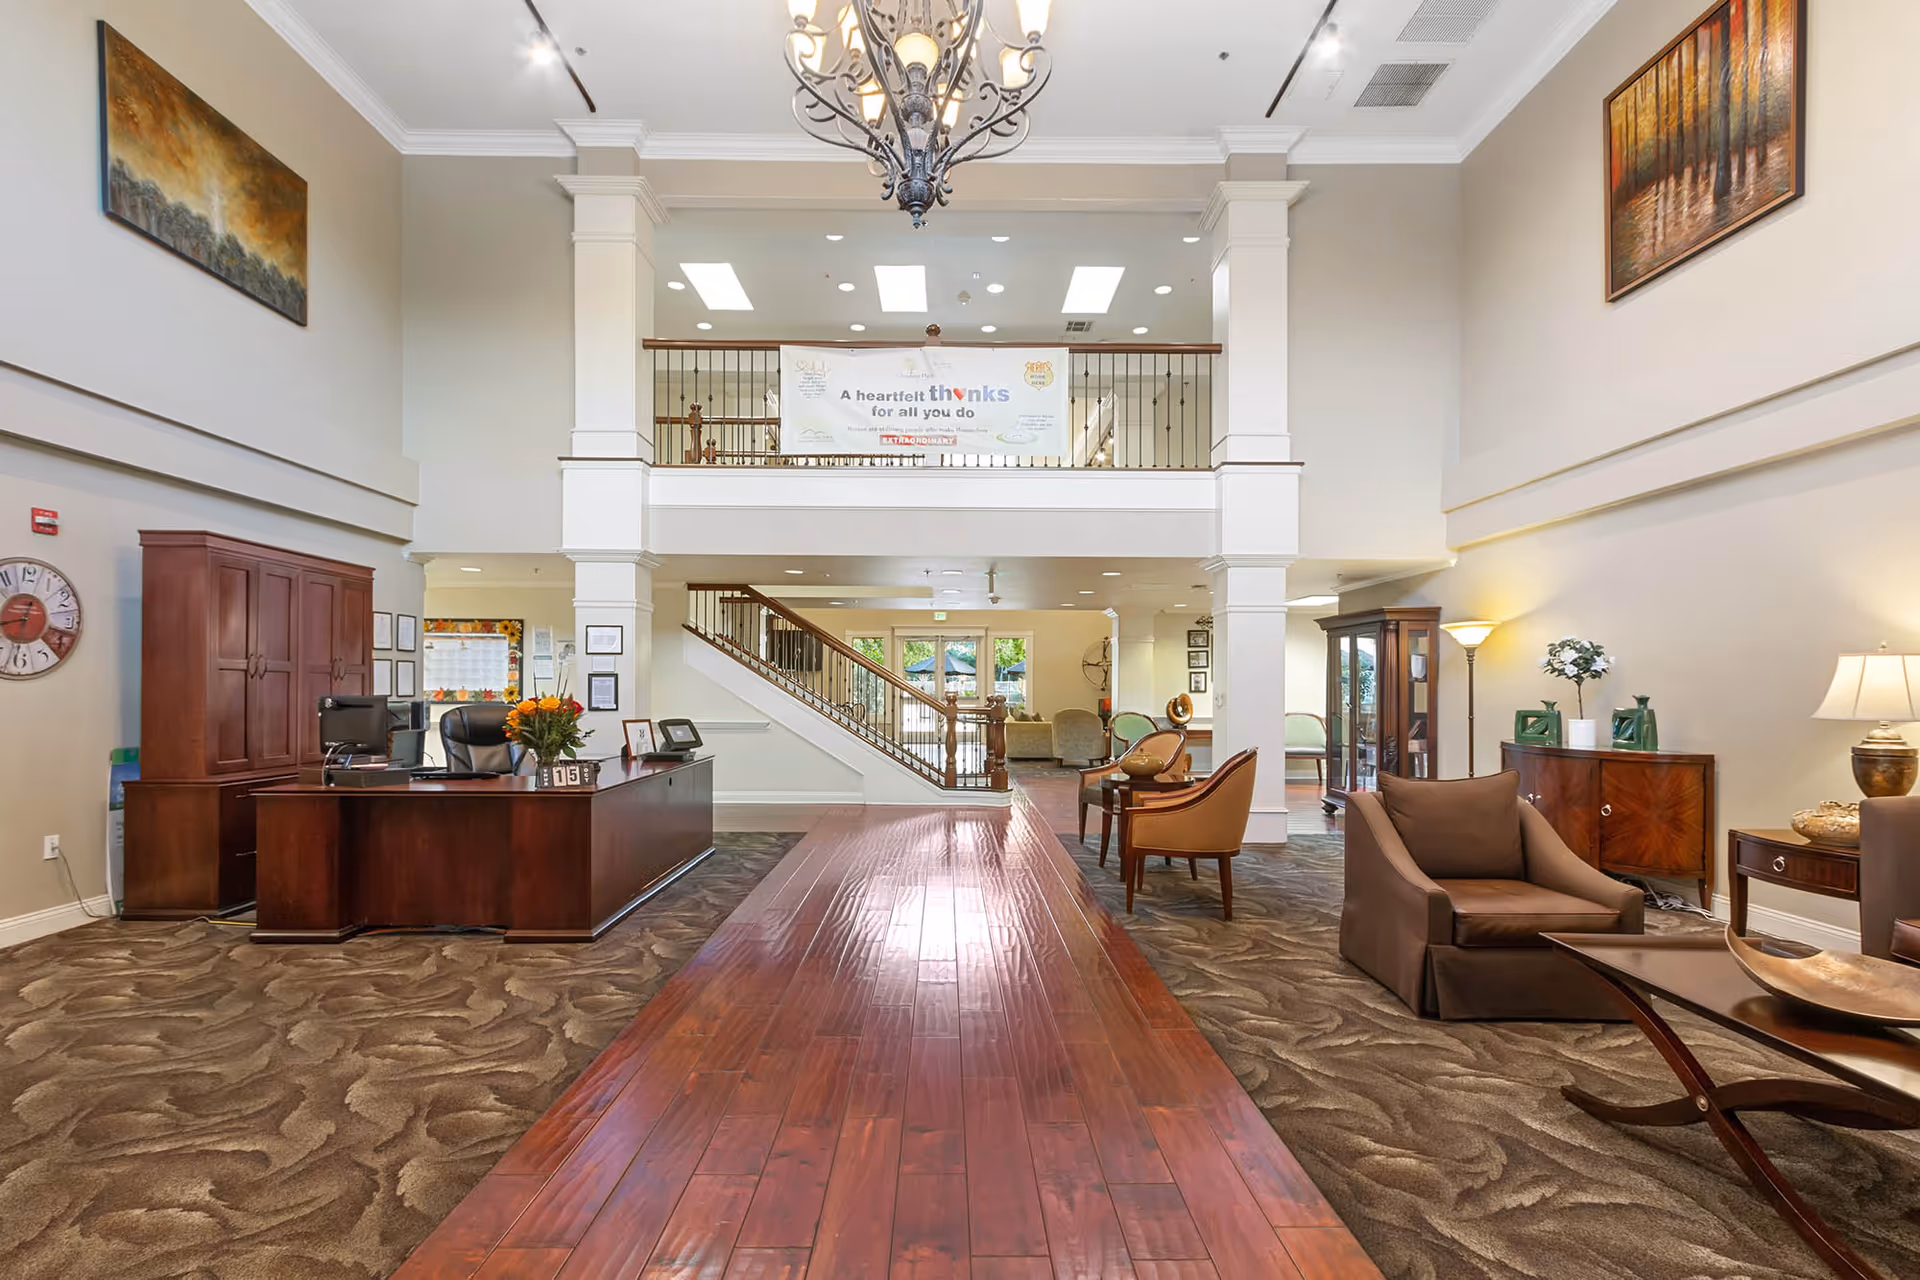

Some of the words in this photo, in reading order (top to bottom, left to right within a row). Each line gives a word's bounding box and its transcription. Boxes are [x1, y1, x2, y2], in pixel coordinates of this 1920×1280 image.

[840, 390, 851, 400] A
[856, 390, 925, 402] heartfelt
[929, 385, 1010, 402] thnks
[872, 406, 894, 417] for
[898, 407, 918, 417] all
[923, 408, 951, 420] you
[956, 407, 975, 418] do
[882, 437, 955, 445] EXTRAORDINARY
[22, 566, 36, 583] 12
[59, 591, 70, 608] 2
[13, 645, 27, 668] 6
[556, 769, 577, 783] 15
